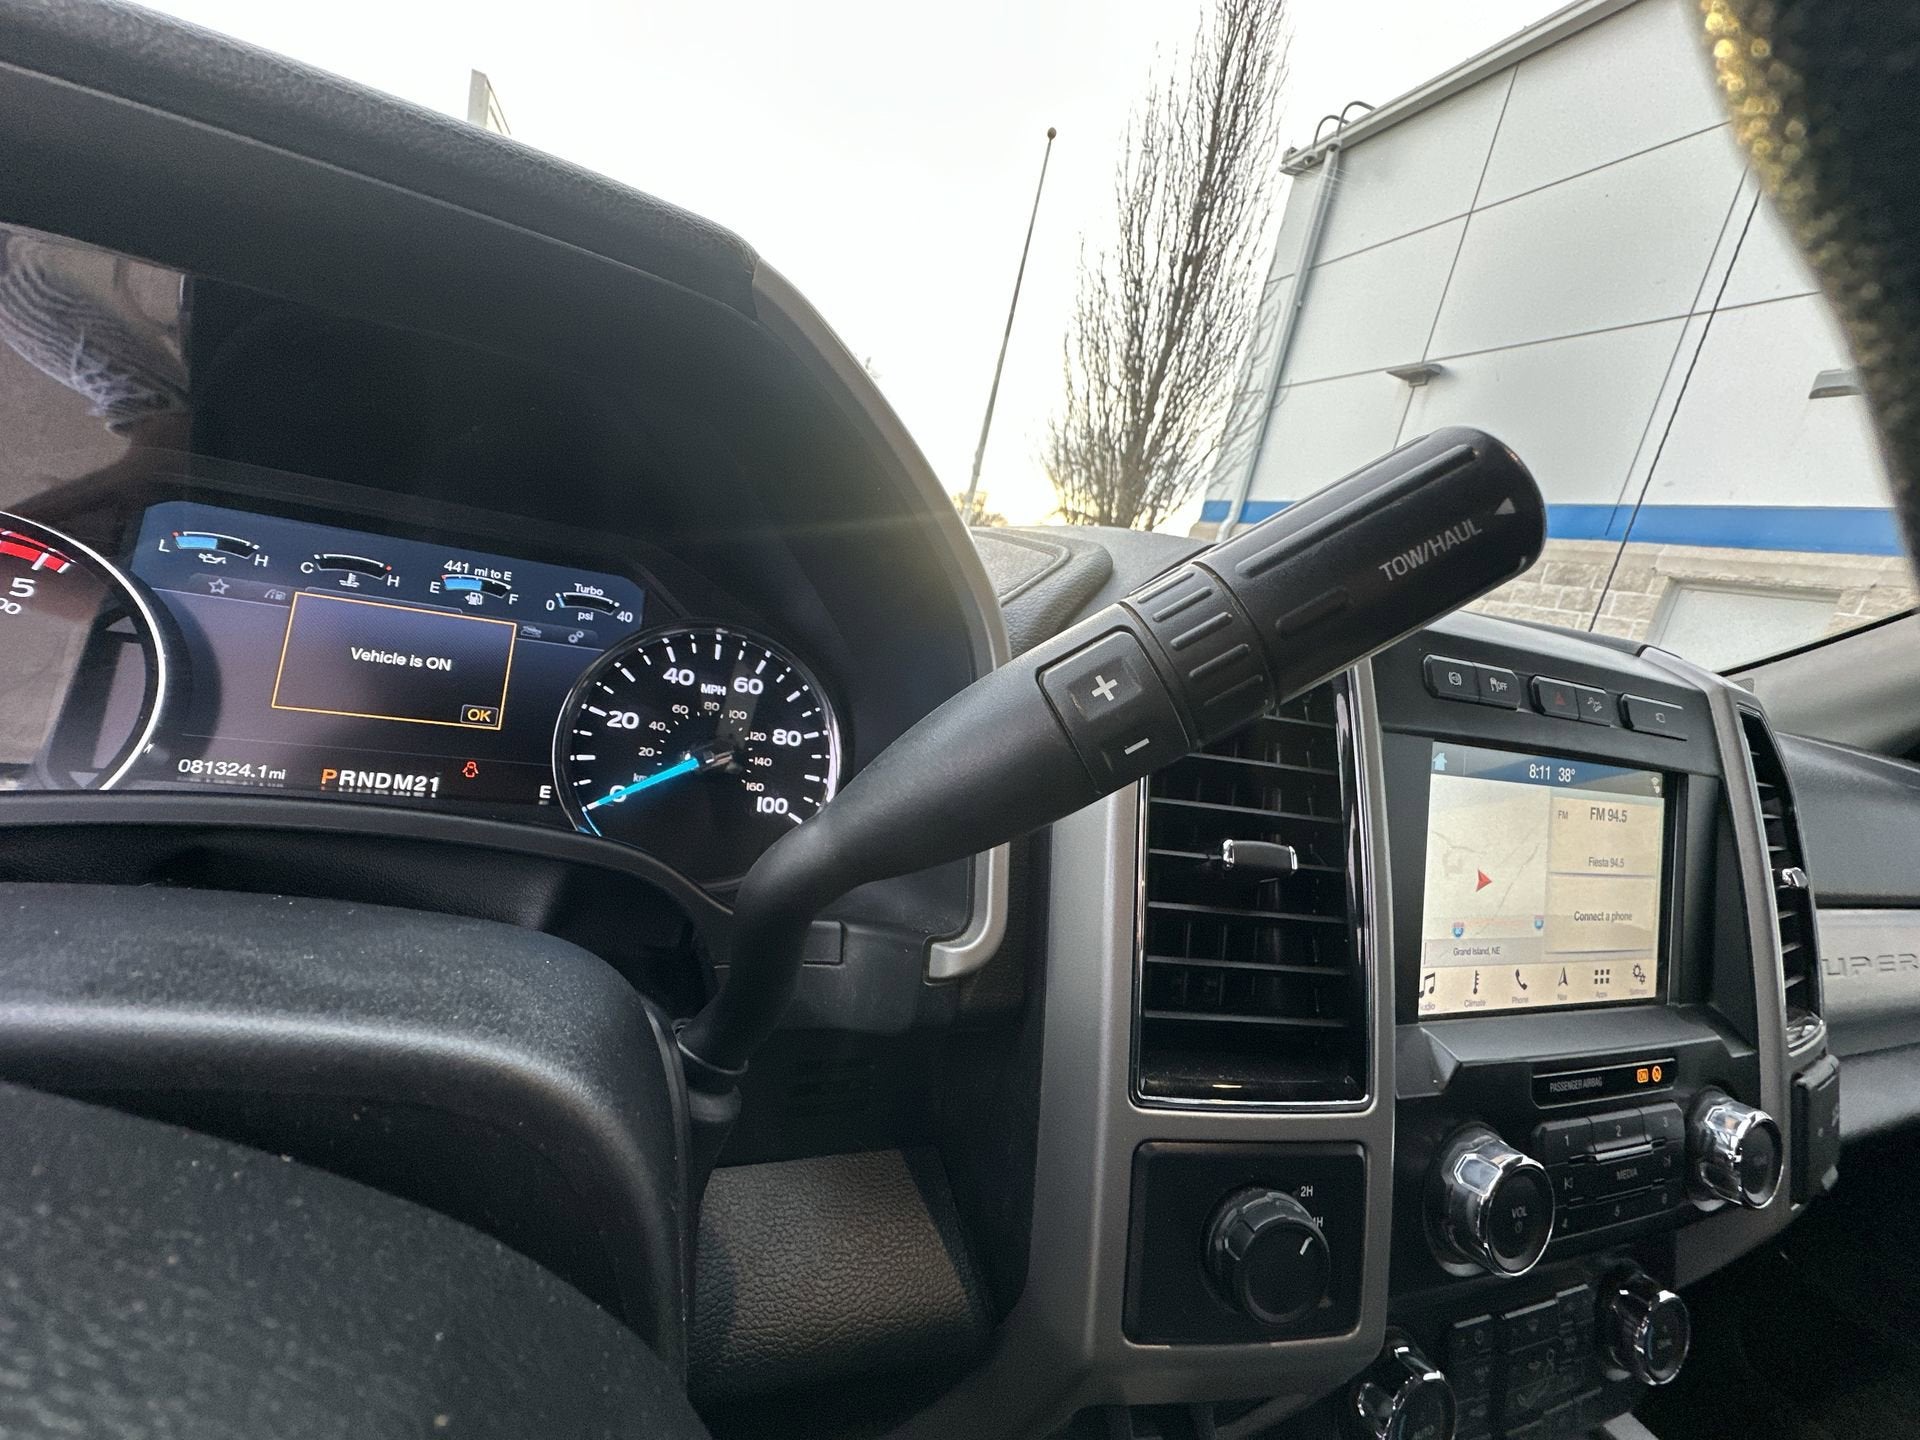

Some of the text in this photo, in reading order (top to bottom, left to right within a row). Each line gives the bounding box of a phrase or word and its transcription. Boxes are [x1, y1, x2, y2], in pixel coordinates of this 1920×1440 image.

[159, 539, 170, 553] L
[1378, 518, 1482, 581] TOW/HAUL
[254, 554, 268, 567] H
[300, 561, 314, 574] C
[444, 560, 512, 581] 441 mi to E
[9, 577, 36, 597] 5
[387, 575, 400, 588] H
[429, 581, 441, 594] E
[574, 583, 604, 596] Turbo
[508, 594, 519, 605] F
[545, 599, 556, 611] 0
[577, 612, 594, 621] psi
[617, 611, 633, 623] 40
[350, 647, 452, 672] Vehicle is ON
[662, 667, 695, 686] 40
[700, 683, 726, 696] MPH
[733, 676, 764, 695] 60
[671, 704, 689, 714] 60
[703, 701, 720, 712] 80
[467, 708, 492, 723] OK
[606, 710, 640, 730] 20
[729, 709, 748, 720] 100
[648, 721, 666, 731] 40
[750, 731, 767, 742] 120
[772, 728, 801, 747] 80
[638, 747, 655, 757] 20
[754, 757, 773, 767] 140
[177, 759, 286, 780] 081324.1 mi
[1529, 763, 1576, 783] 8:11 38°
[539, 784, 553, 800] E
[746, 782, 765, 792] 160
[756, 796, 789, 814] 100
[1557, 810, 1569, 820] FM
[1590, 806, 1628, 824] FM 94.5
[1588, 856, 1625, 869] Fiesta 94.5
[1574, 910, 1604, 922] Connect
[1611, 910, 1633, 923] phone
[1453, 947, 1472, 957] Grand
[1491, 945, 1501, 955] NE
[1463, 1000, 1487, 1009] Climate
[1550, 1078, 1583, 1093] PASSENGER
[1663, 1115, 1669, 1128] 3
[1616, 1124, 1622, 1137] 2
[1564, 1134, 1570, 1147] 1
[1616, 1167, 1638, 1181] MEDIA
[1300, 1185, 1314, 1197] 2H
[1511, 1206, 1529, 1219] VOL
